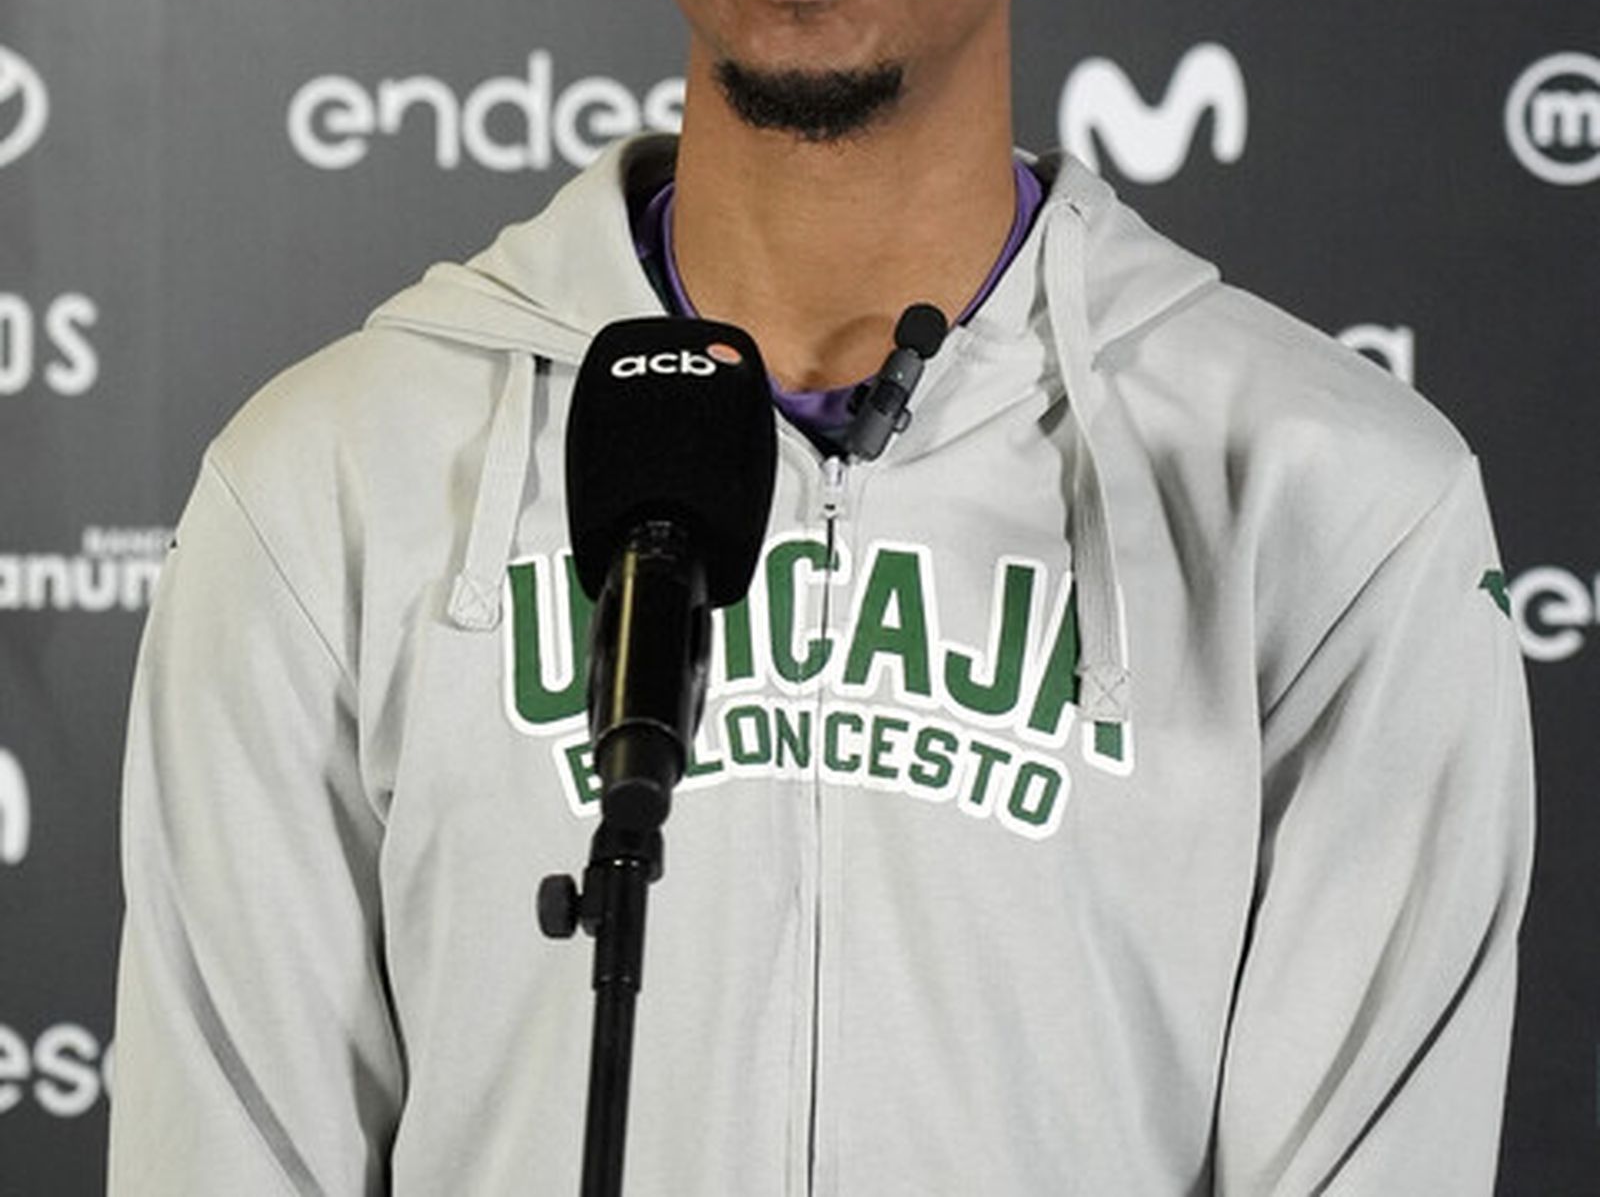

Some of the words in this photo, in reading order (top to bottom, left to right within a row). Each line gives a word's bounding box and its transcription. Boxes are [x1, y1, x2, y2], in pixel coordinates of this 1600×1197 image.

[611, 349, 717, 378] acb
[504, 537, 1130, 768] UICAJA
[563, 703, 1064, 827] BLONCESTO
